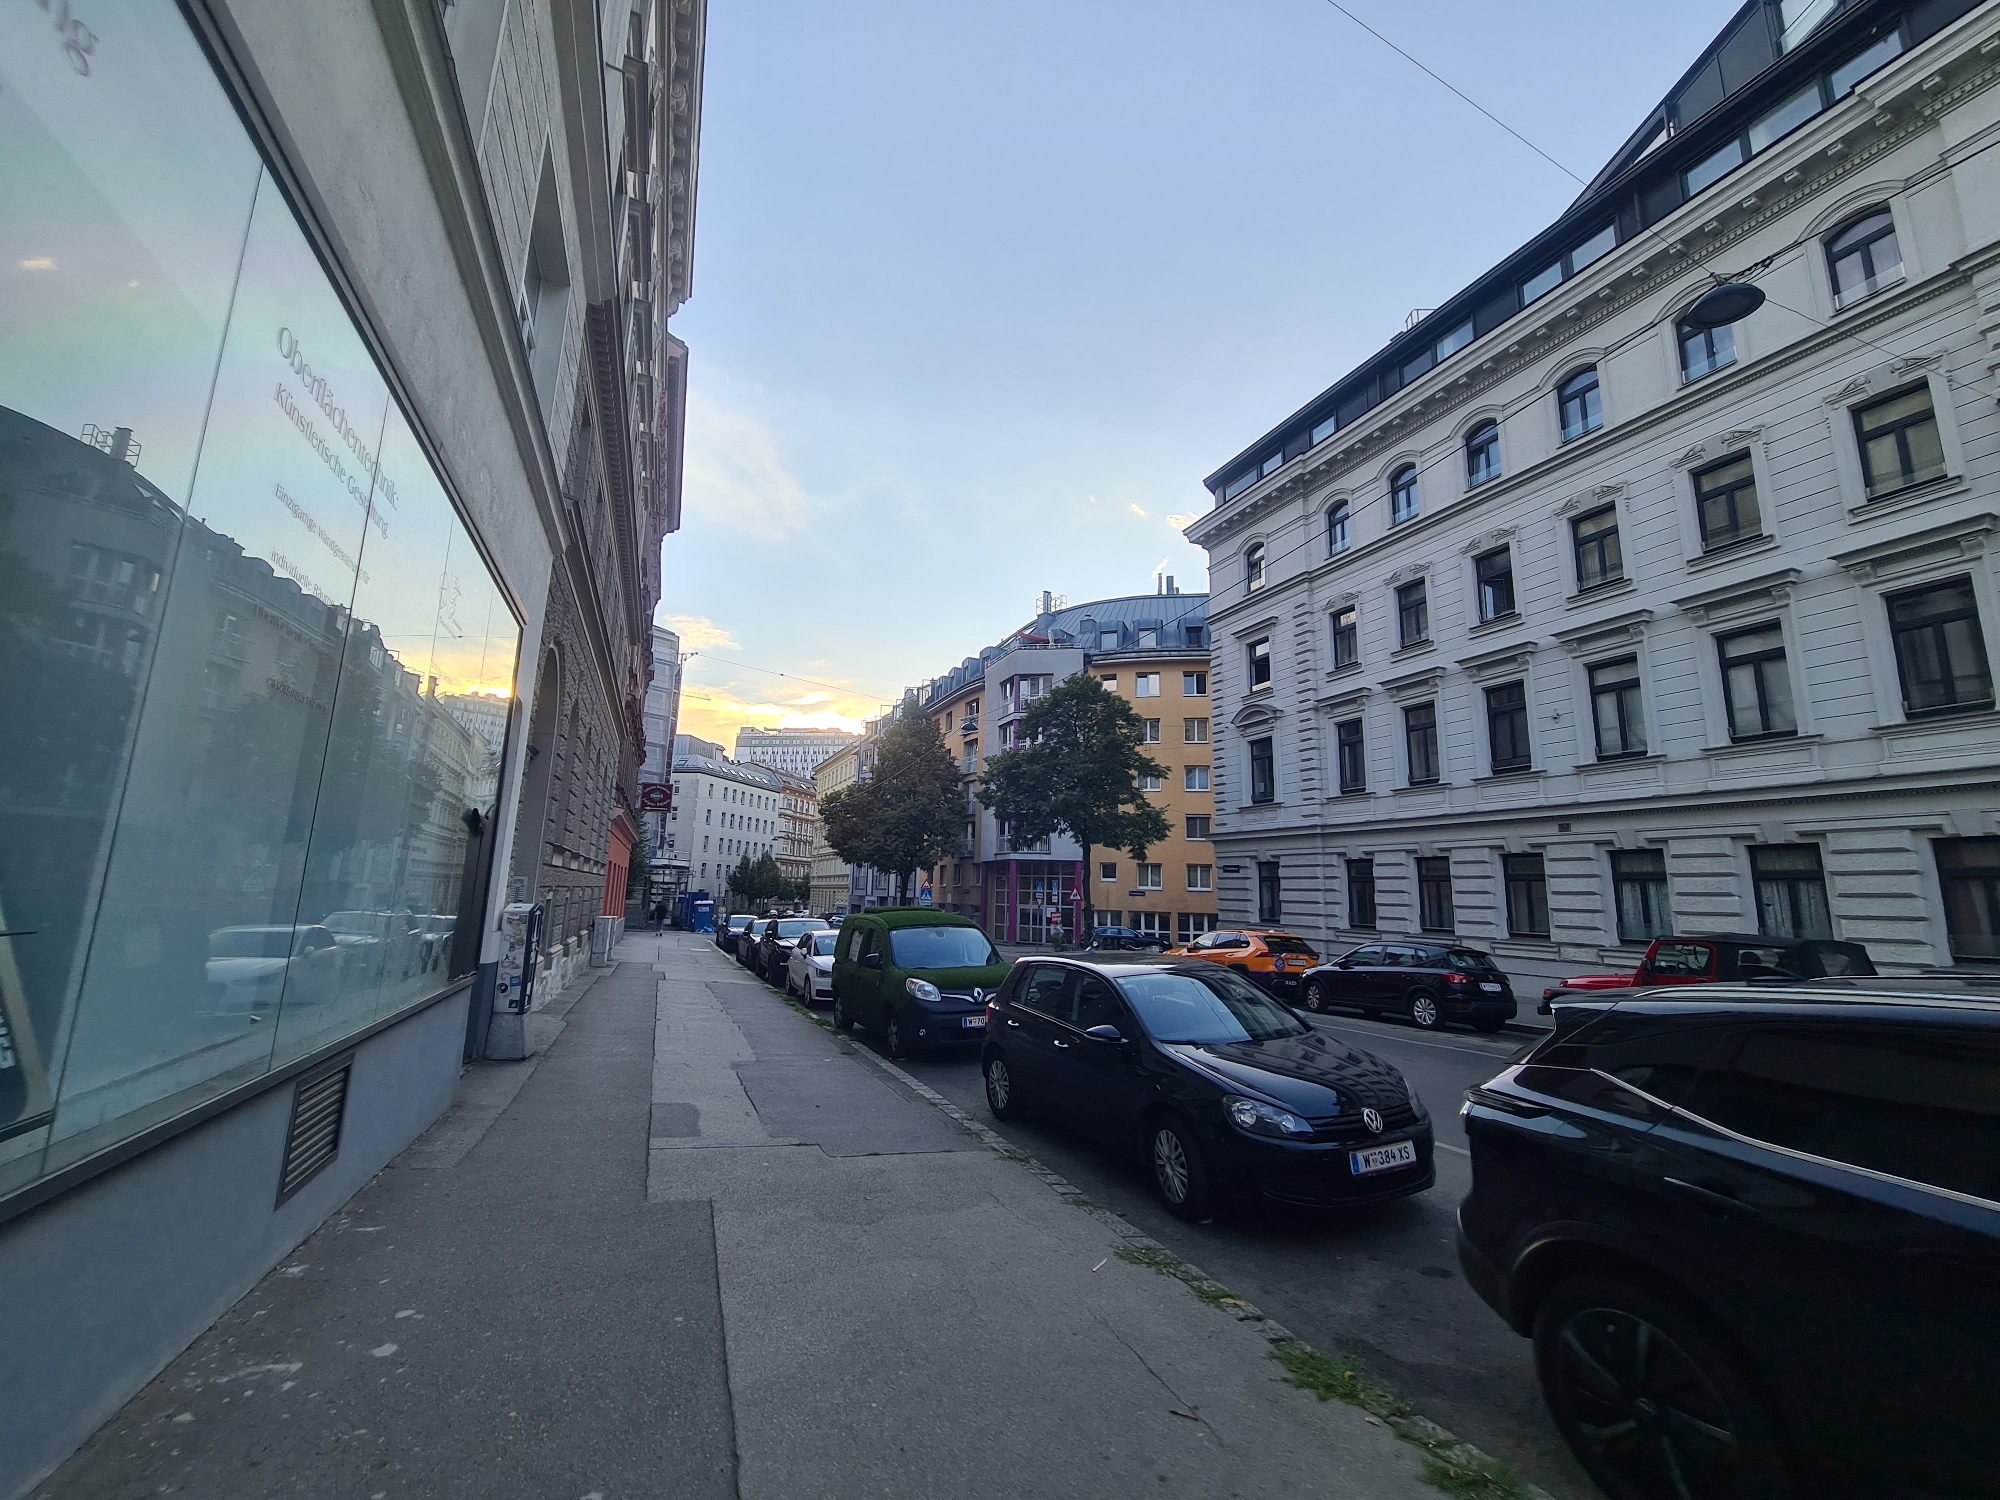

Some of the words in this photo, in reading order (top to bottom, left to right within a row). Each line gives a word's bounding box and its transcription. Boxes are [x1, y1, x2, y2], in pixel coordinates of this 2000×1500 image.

[274, 382, 347, 484] Künstlerische
[1362, 1153, 1372, 1169] W
[1377, 1149, 1397, 1166] 384
[1397, 1145, 1410, 1161] XS
